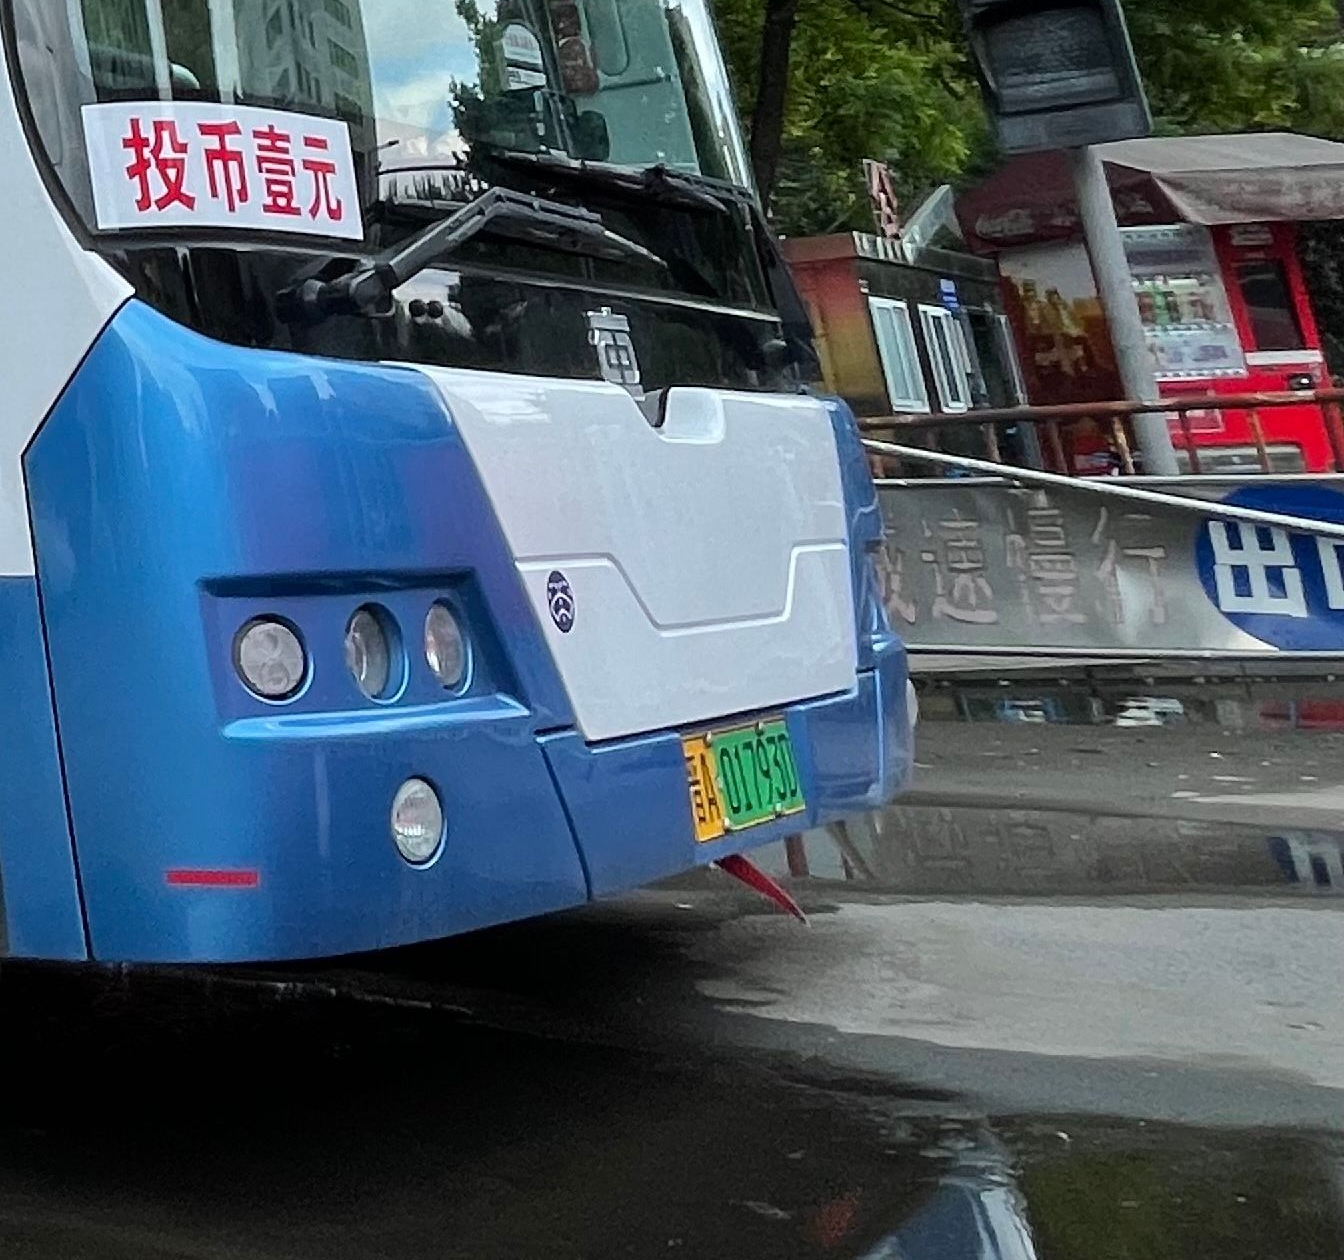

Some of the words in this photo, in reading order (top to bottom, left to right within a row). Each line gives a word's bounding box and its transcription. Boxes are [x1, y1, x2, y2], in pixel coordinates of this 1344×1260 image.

[123, 117, 342, 221] 投币壹元
[1207, 520, 1344, 618] 出
